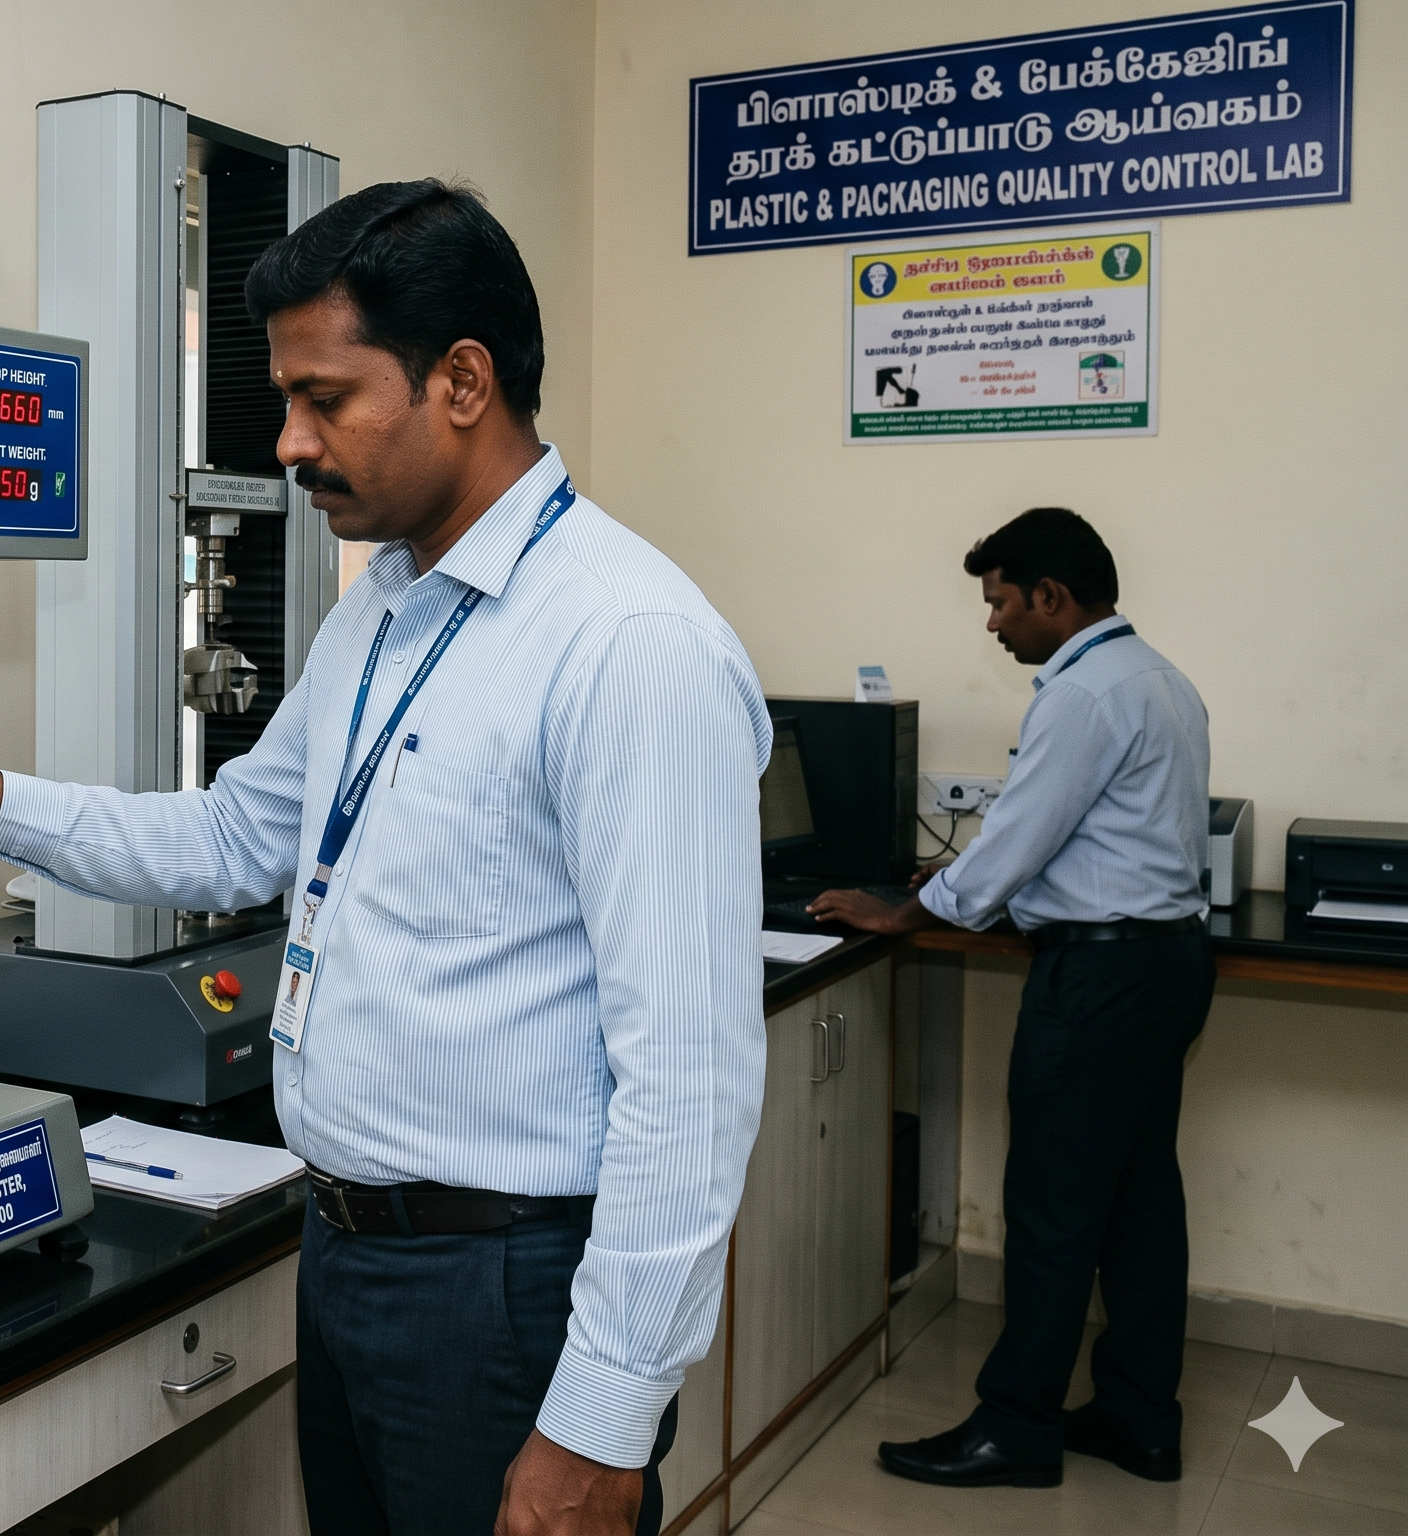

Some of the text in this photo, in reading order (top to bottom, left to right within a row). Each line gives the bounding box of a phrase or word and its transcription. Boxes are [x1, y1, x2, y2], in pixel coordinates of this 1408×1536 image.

[970, 64, 1003, 101] &
[726, 79, 1302, 186] தரக் கட்டுப்பாடு ஆய்வகம்
[709, 141, 1324, 231] PLASTIC & PACKAGING QUALITY CONTROL LAB
[0, 393, 41, 424] 660
[48, 409, 64, 420] mm
[29, 481, 39, 502] g
